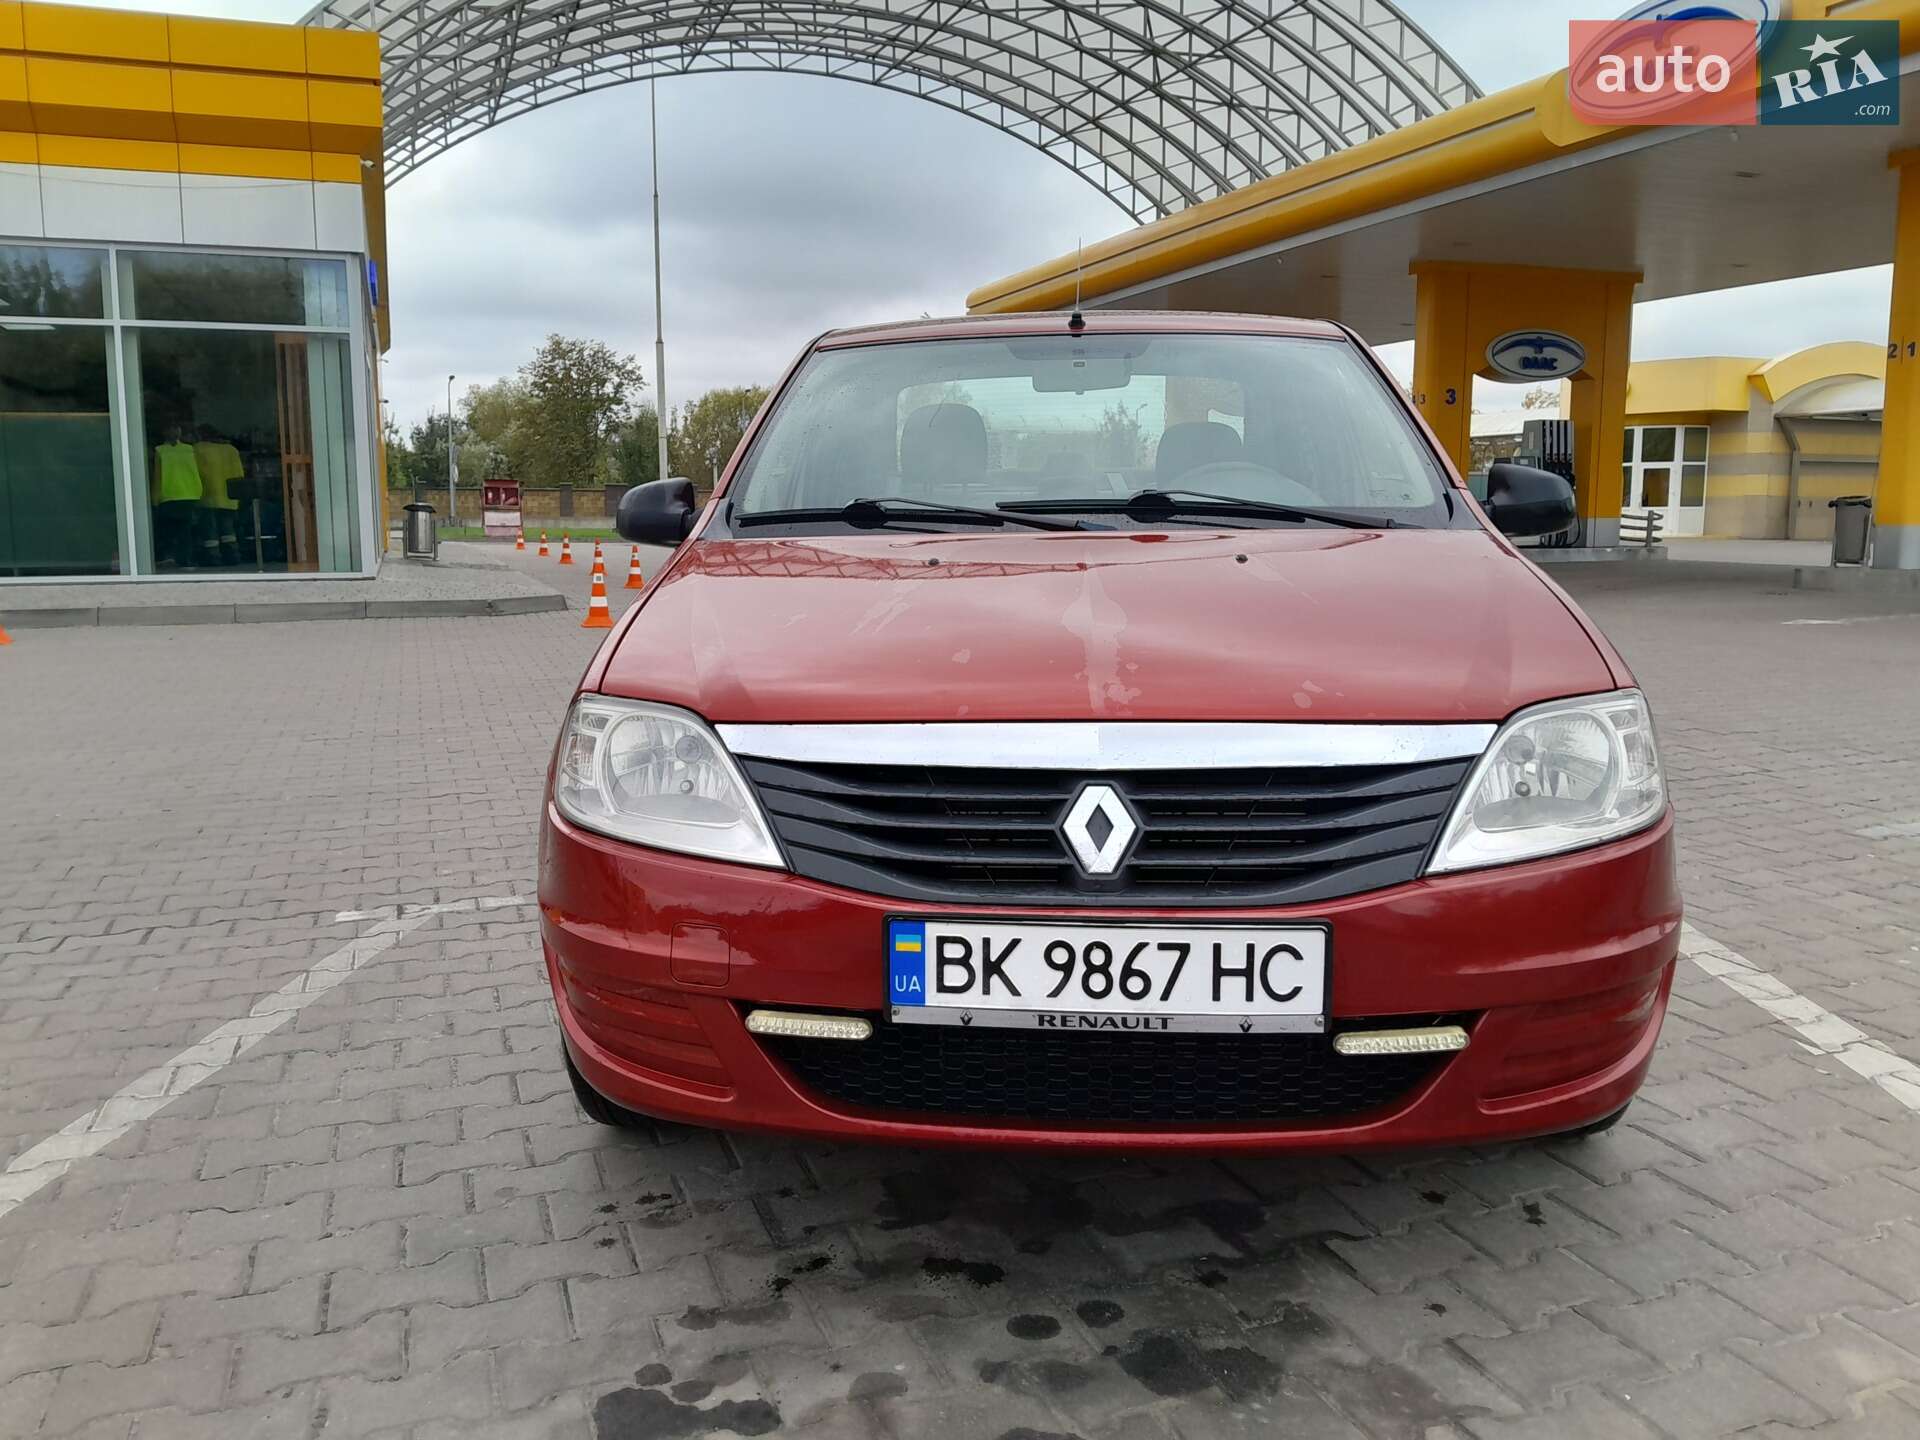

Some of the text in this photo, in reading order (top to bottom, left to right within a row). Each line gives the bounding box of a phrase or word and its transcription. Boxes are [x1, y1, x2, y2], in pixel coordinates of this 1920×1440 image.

[1907, 341, 1916, 357] 1
[1445, 388, 1456, 405] 3
[936, 935, 1304, 1002] BK 9867 HC
[895, 975, 922, 993] UA
[1037, 1014, 1173, 1031] RENAULT
